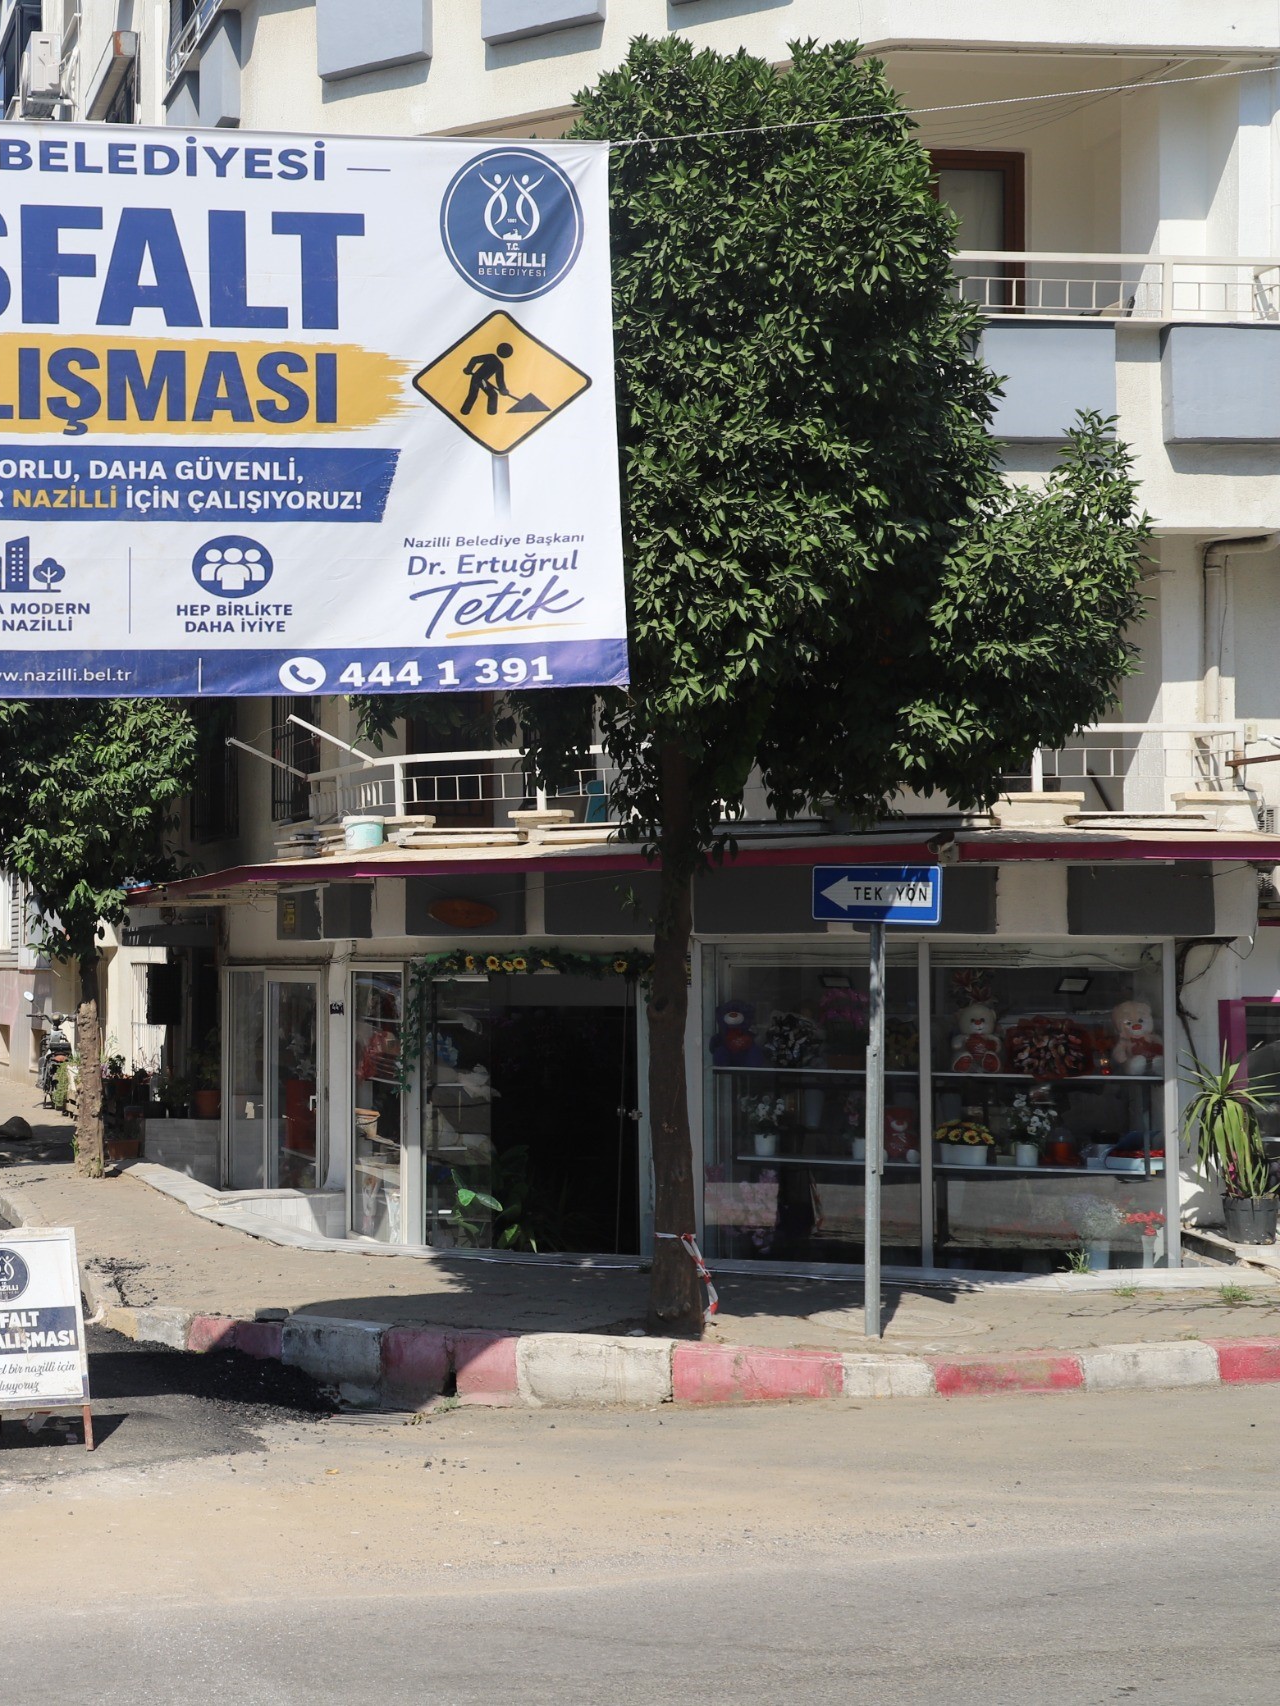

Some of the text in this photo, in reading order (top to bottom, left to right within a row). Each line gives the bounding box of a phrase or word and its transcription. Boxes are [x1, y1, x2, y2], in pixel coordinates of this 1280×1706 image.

[0, 134, 325, 181] BELEDİYESİ
[506, 243, 520, 251] T.C.
[89, 460, 167, 480] DAHA
[175, 457, 304, 484] GÜVENLİ,
[13, 485, 117, 508] NAZİLLİ
[126, 485, 179, 513] İÇİN
[187, 490, 362, 514] ÇALIŞIYORUZ!
[404, 533, 584, 548] Nazilli Belediye Başkanı
[407, 549, 578, 578] Dr. Ertuğrul
[10, 602, 91, 616] MODERN
[176, 601, 293, 617] HEP BİRLİKTE
[409, 575, 585, 639] Tetik
[2, 616, 73, 632] NAZİLLİ
[185, 617, 286, 633] DAHA İYİYE
[339, 656, 554, 687] 444 1 391
[854, 883, 927, 902] TEK YÖN
[8, 1363, 23, 1374] bir
[24, 1361, 56, 1377] nazilli
[57, 1360, 76, 1374] için
